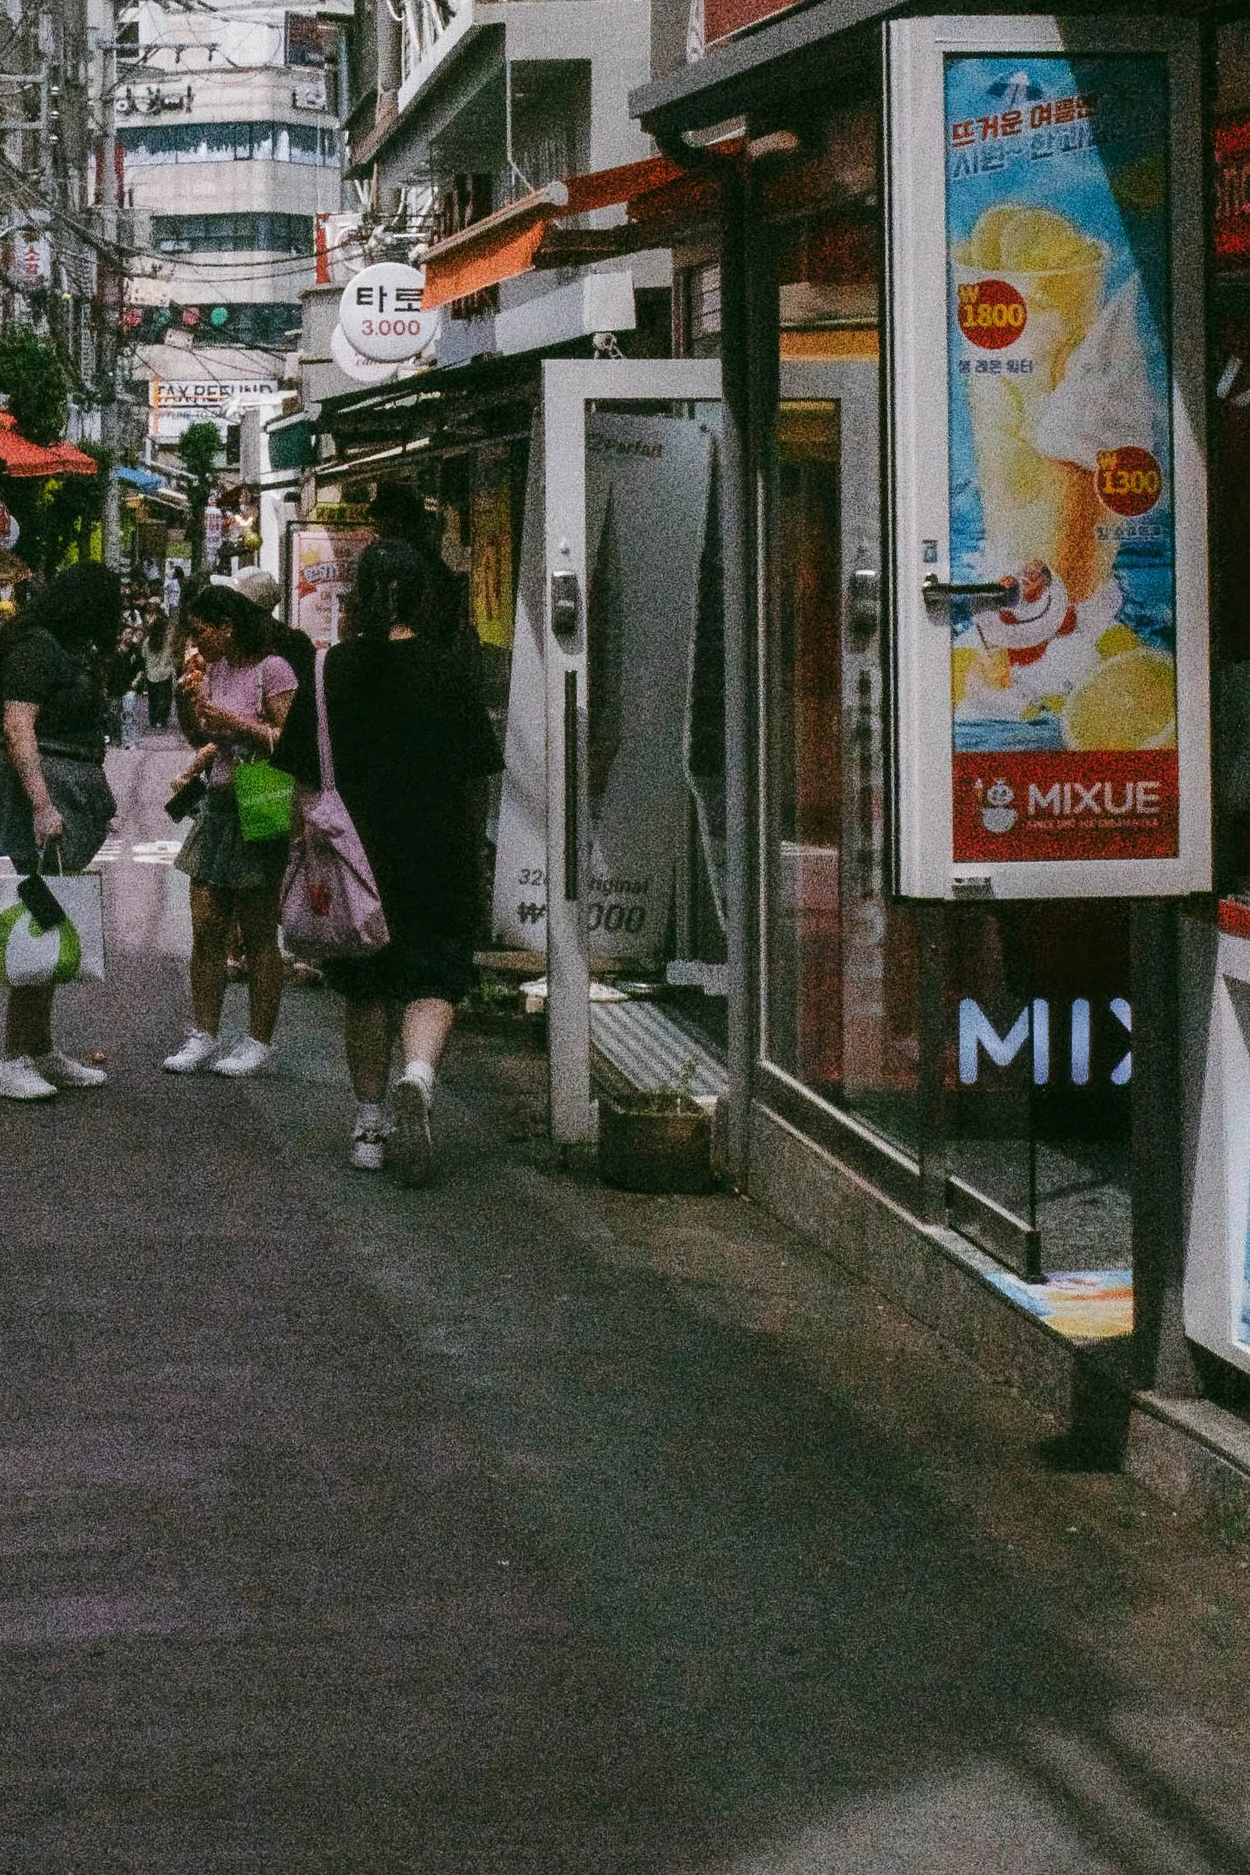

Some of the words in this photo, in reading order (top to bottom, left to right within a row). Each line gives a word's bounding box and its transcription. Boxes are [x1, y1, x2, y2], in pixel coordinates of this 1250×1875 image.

[951, 109, 1023, 148] 뜨거운
[356, 286, 424, 313] 타로
[962, 303, 1025, 328] 1800
[1027, 780, 1161, 815] MIXUE
